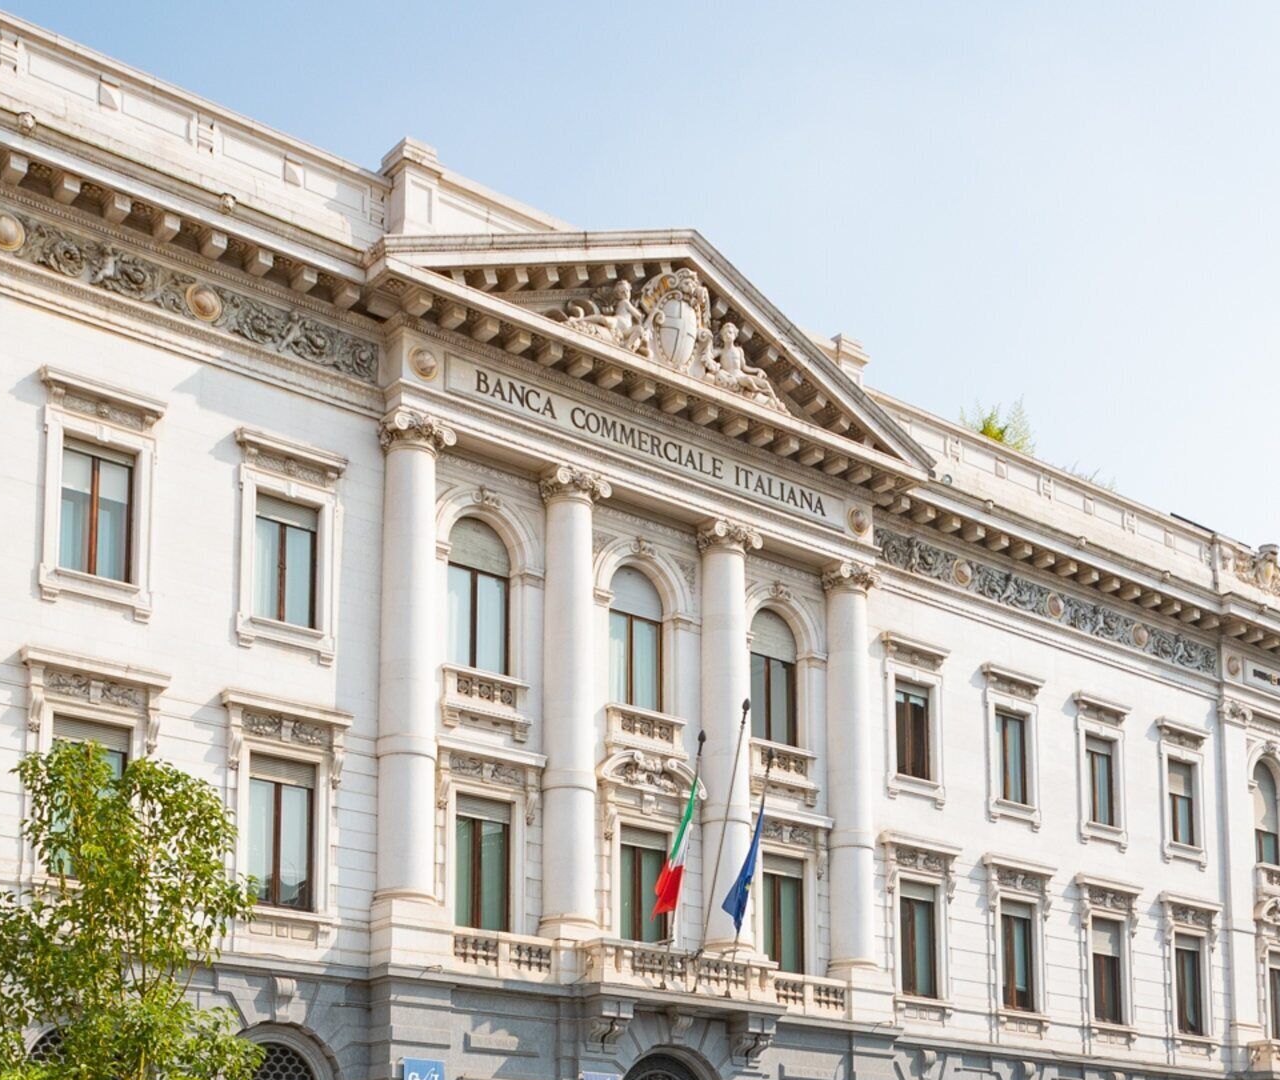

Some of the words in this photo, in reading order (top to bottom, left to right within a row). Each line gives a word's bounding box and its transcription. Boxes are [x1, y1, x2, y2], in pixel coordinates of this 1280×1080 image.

[475, 370, 557, 420] BANCA
[570, 407, 724, 479] COMMERCIALE
[735, 465, 826, 517] ITALIANA
